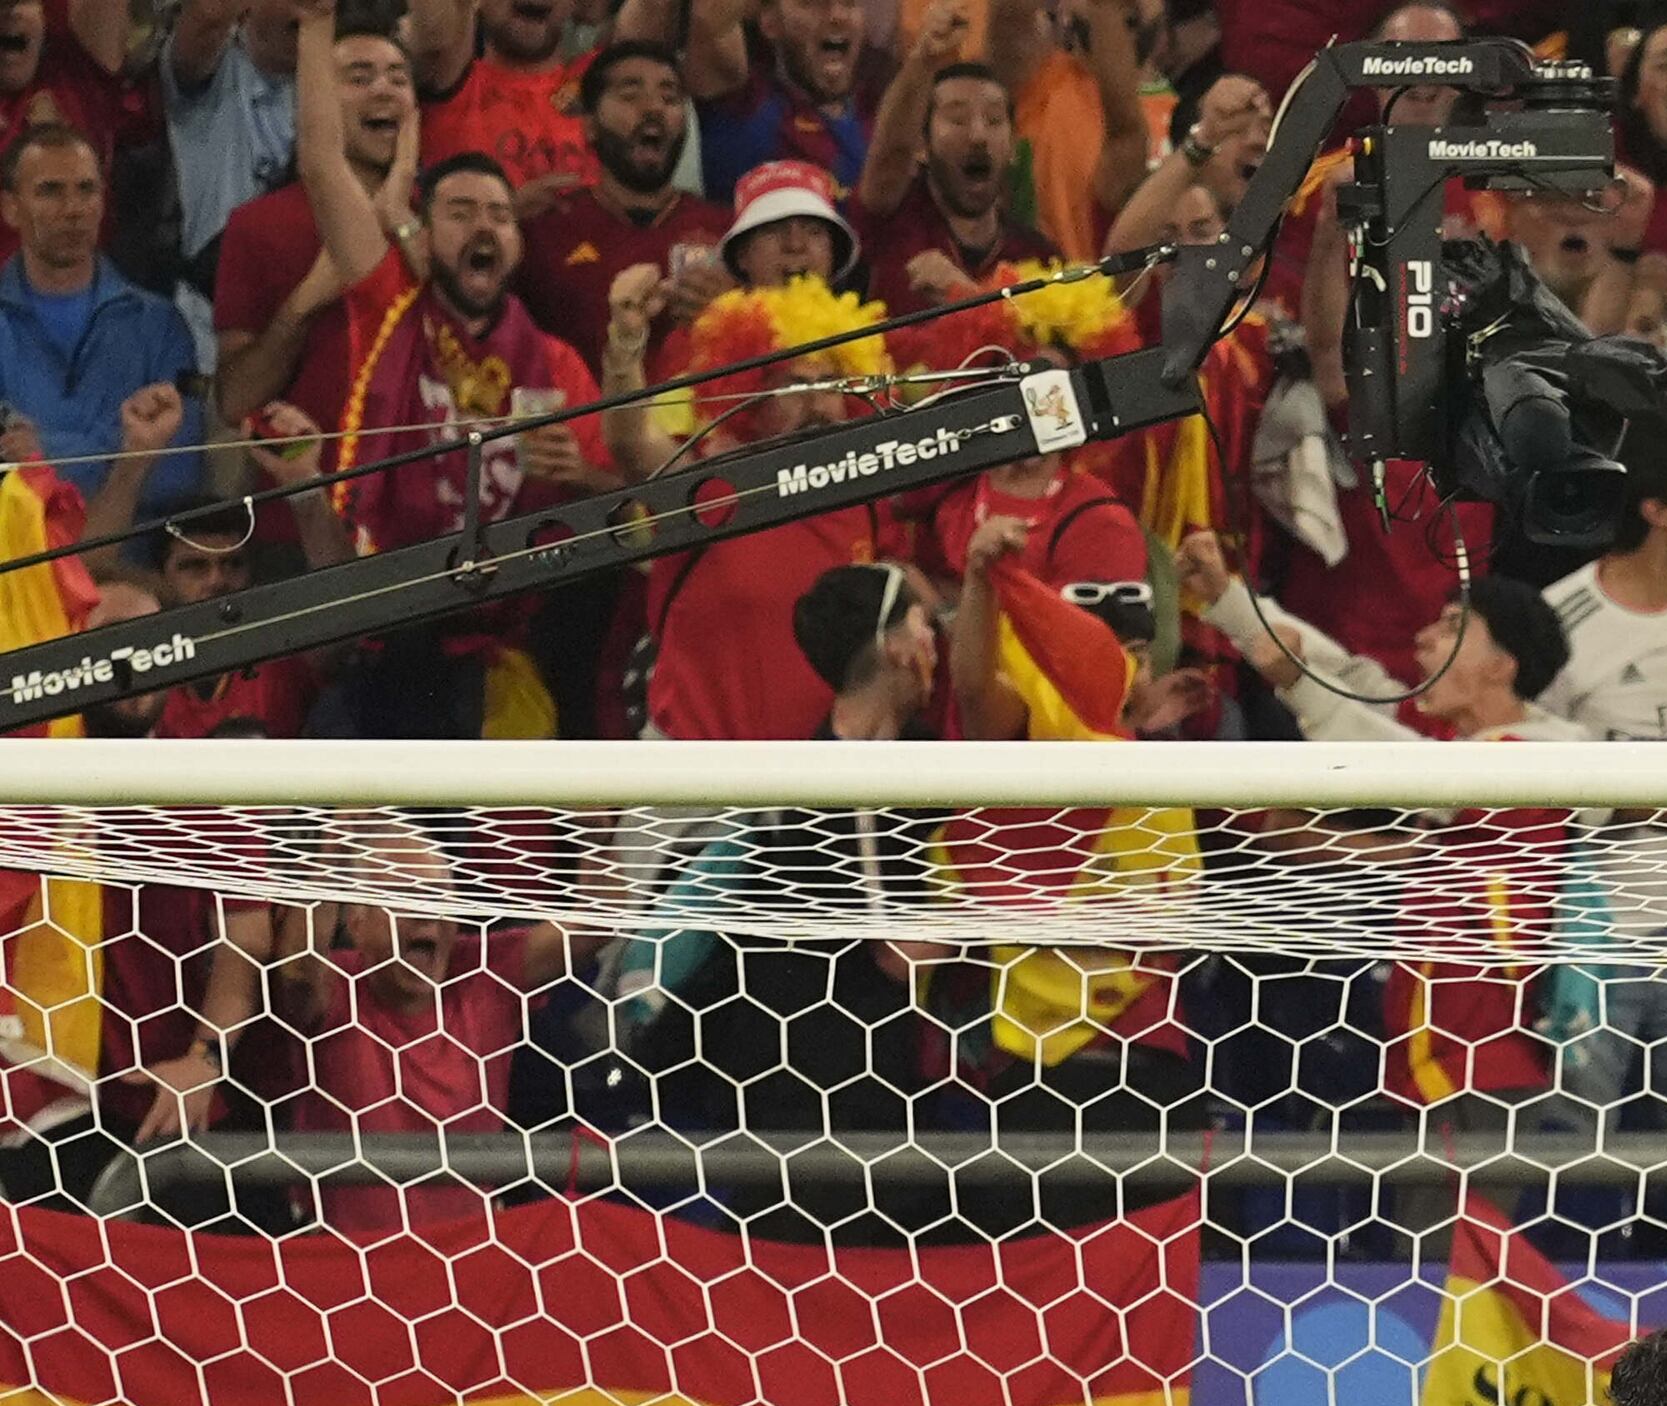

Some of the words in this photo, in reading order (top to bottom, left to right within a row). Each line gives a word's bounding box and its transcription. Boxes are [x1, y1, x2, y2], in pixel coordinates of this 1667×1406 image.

[1362, 57, 1473, 75] MovieTech
[1428, 140, 1537, 158] MovieTech
[1407, 261, 1432, 338] P10
[777, 428, 960, 497] MovieTech
[11, 633, 196, 705] MovieTech
